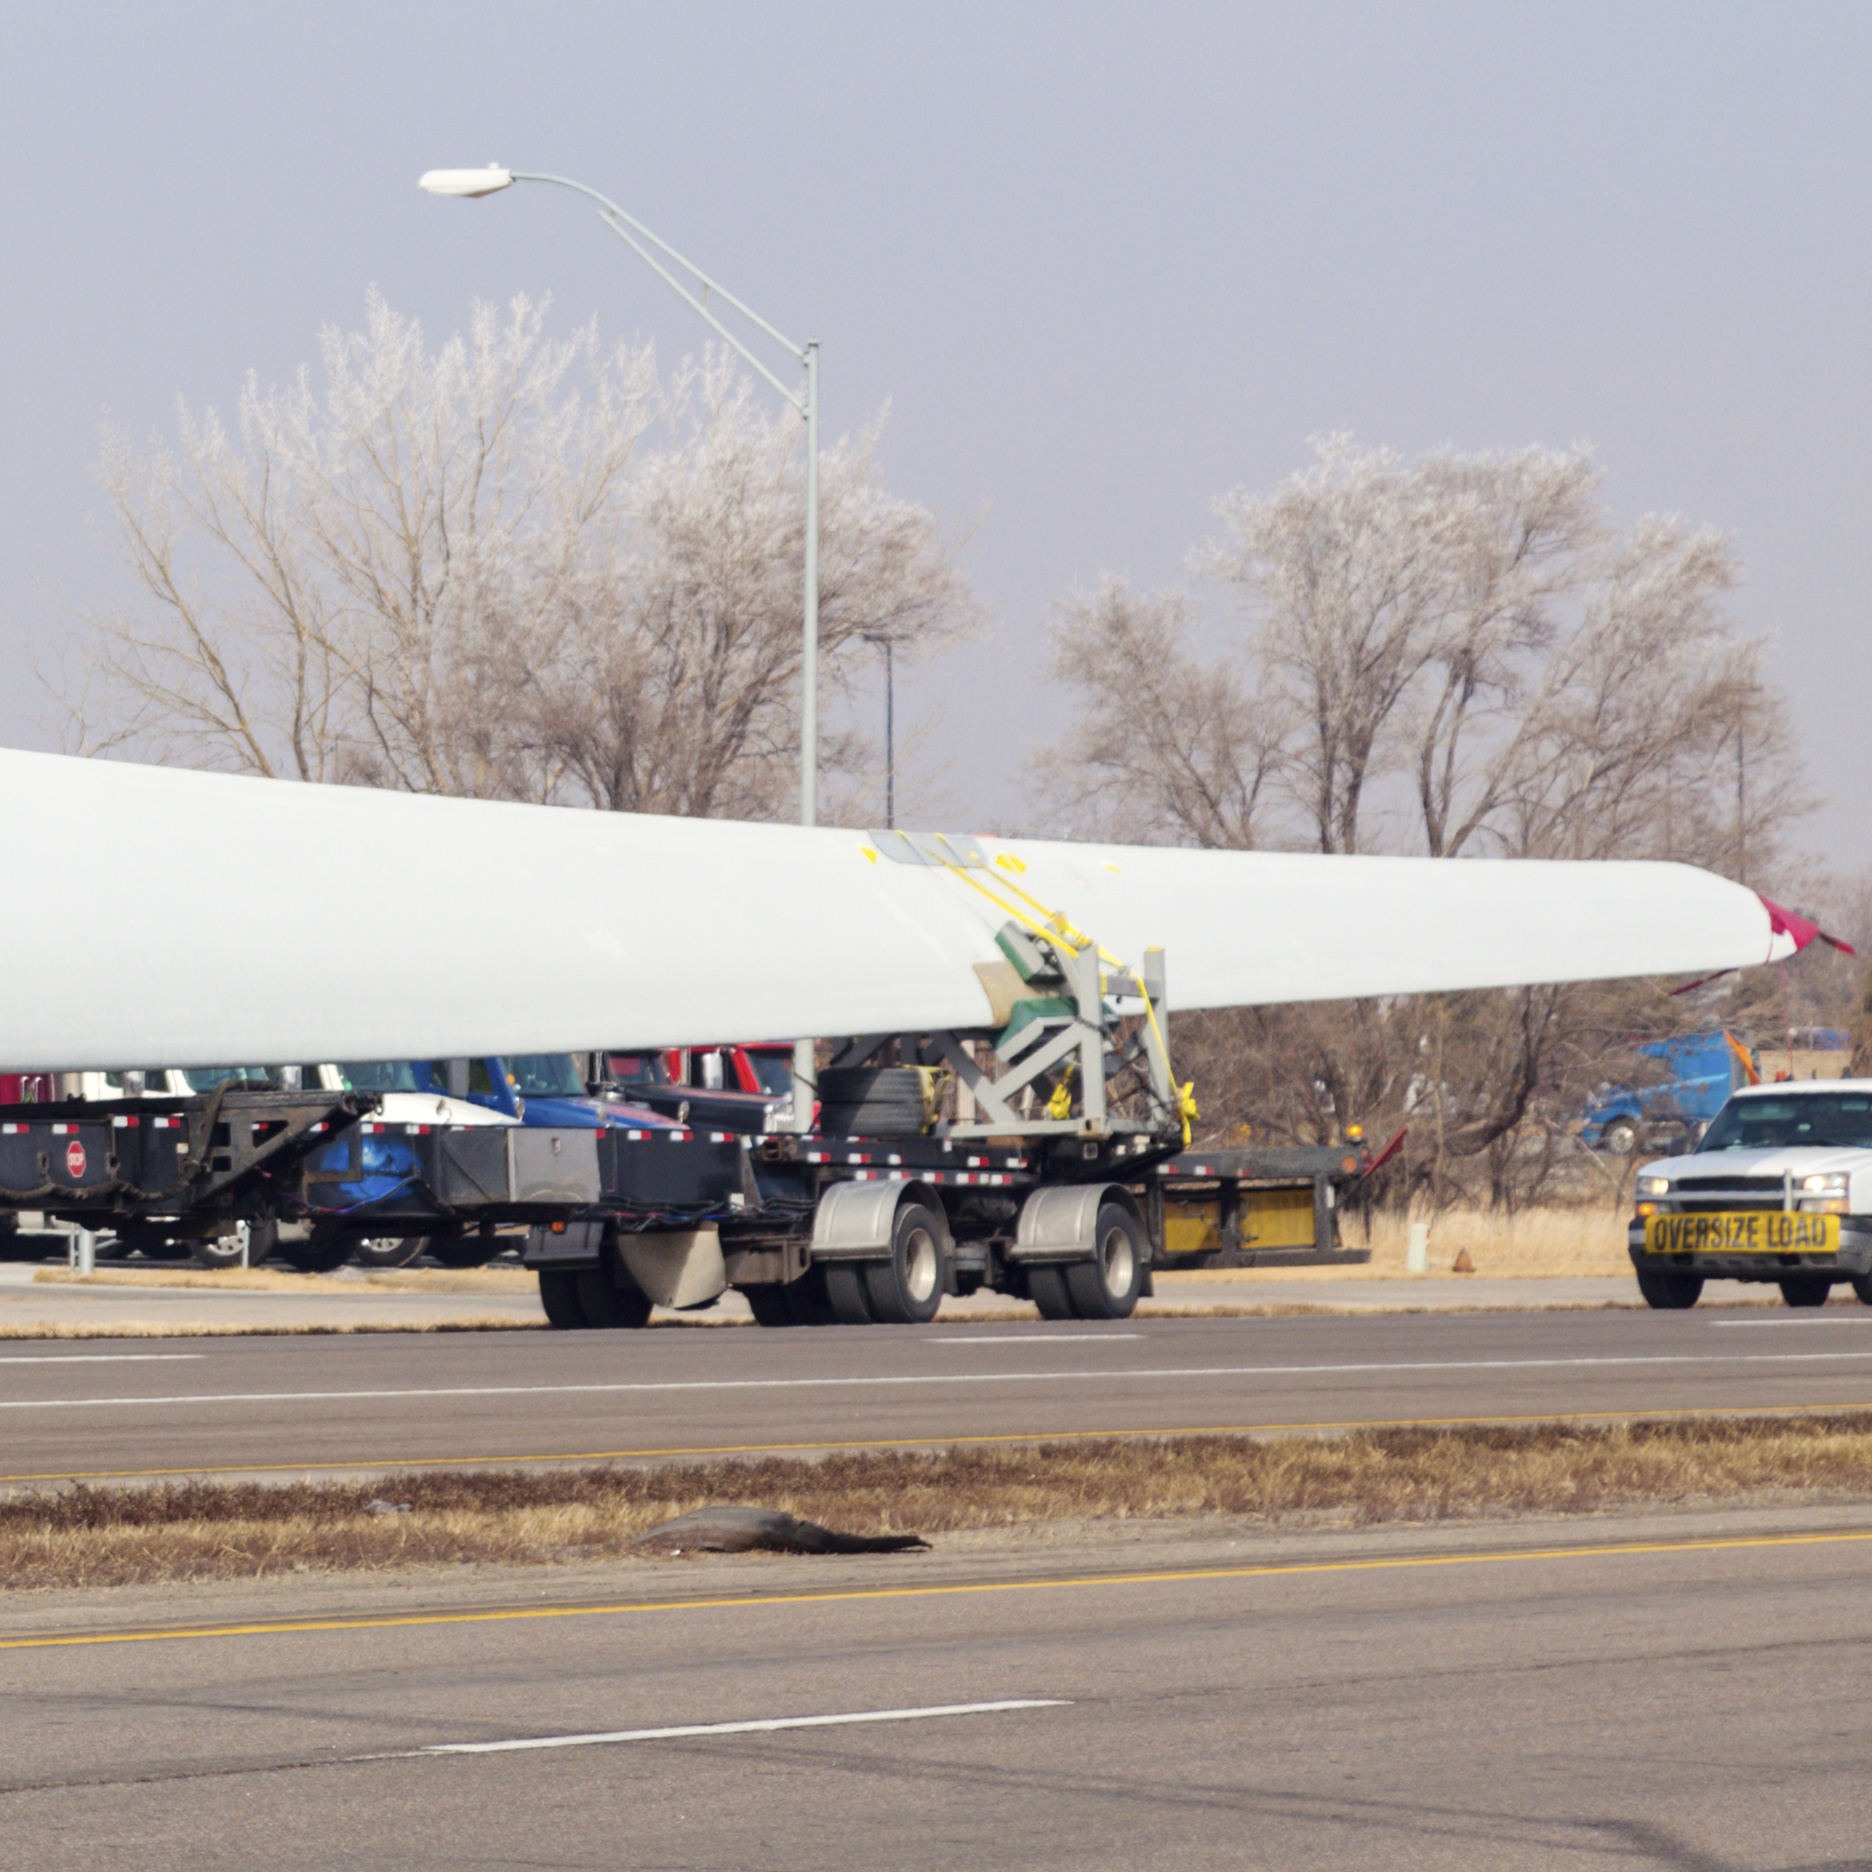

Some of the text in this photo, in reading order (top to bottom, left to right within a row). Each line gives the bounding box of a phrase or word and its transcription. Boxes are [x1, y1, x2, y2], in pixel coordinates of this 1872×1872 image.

[68, 1152, 84, 1166] STOP
[1654, 1215, 1827, 1250] OVERSIZE LOAD
